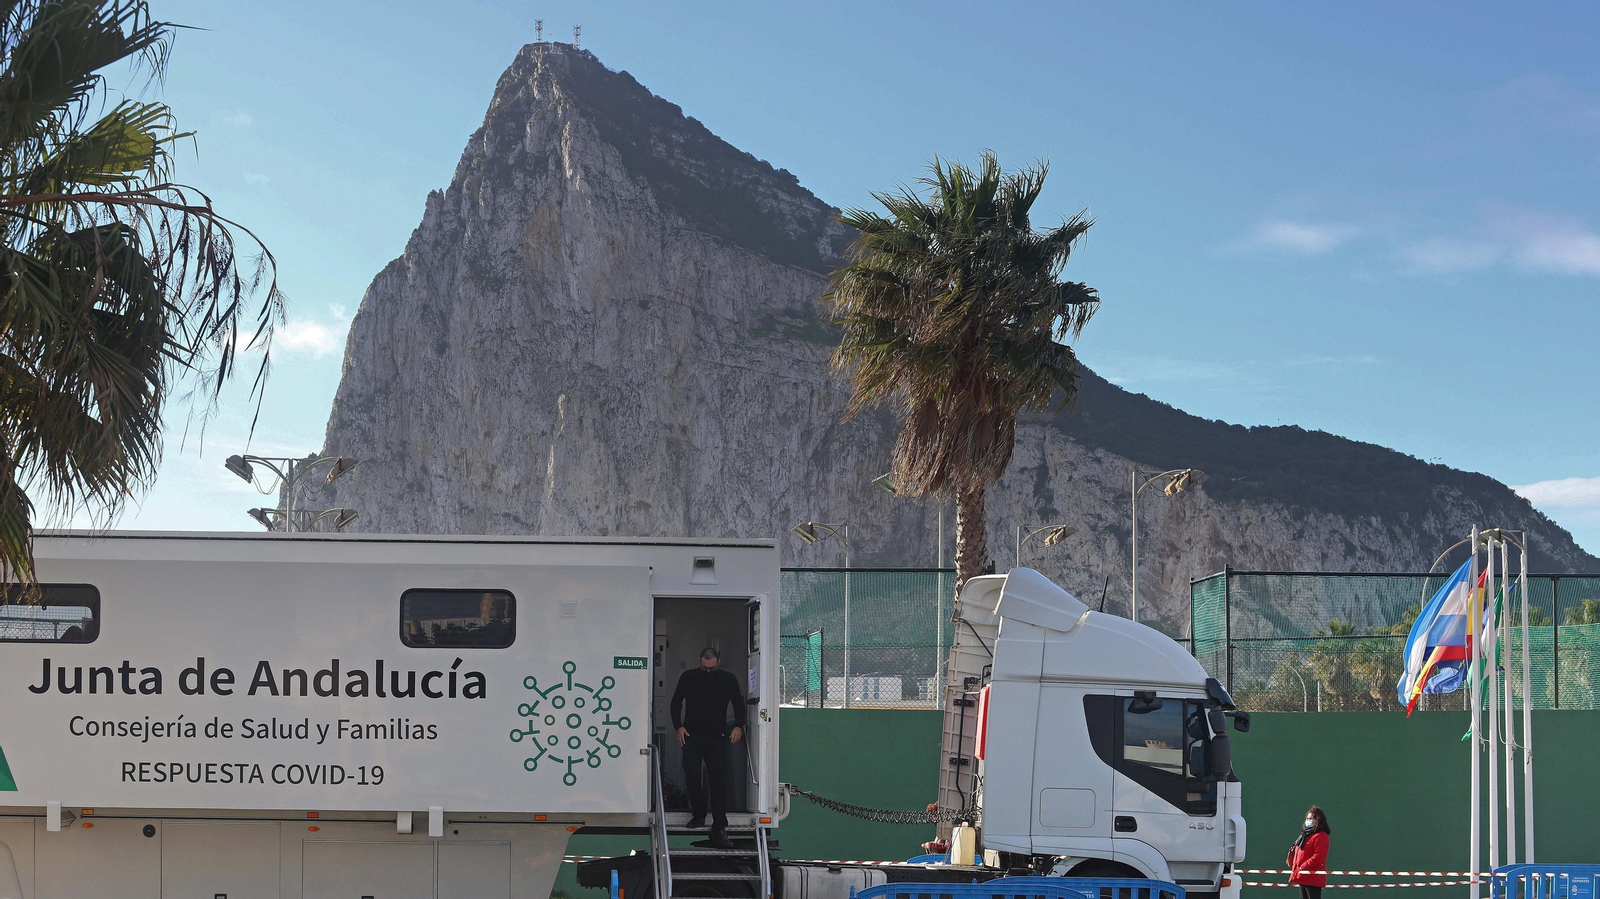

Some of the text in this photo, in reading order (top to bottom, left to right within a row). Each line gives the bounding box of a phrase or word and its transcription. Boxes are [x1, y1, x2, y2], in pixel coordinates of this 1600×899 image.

[617, 659, 644, 667] SALIDA
[28, 656, 487, 700] Junta de Andalucía
[69, 714, 438, 745] Consejería de Salud y Familias
[121, 761, 384, 786] RESPUESTA COVID-19
[1189, 822, 1215, 831] 450
